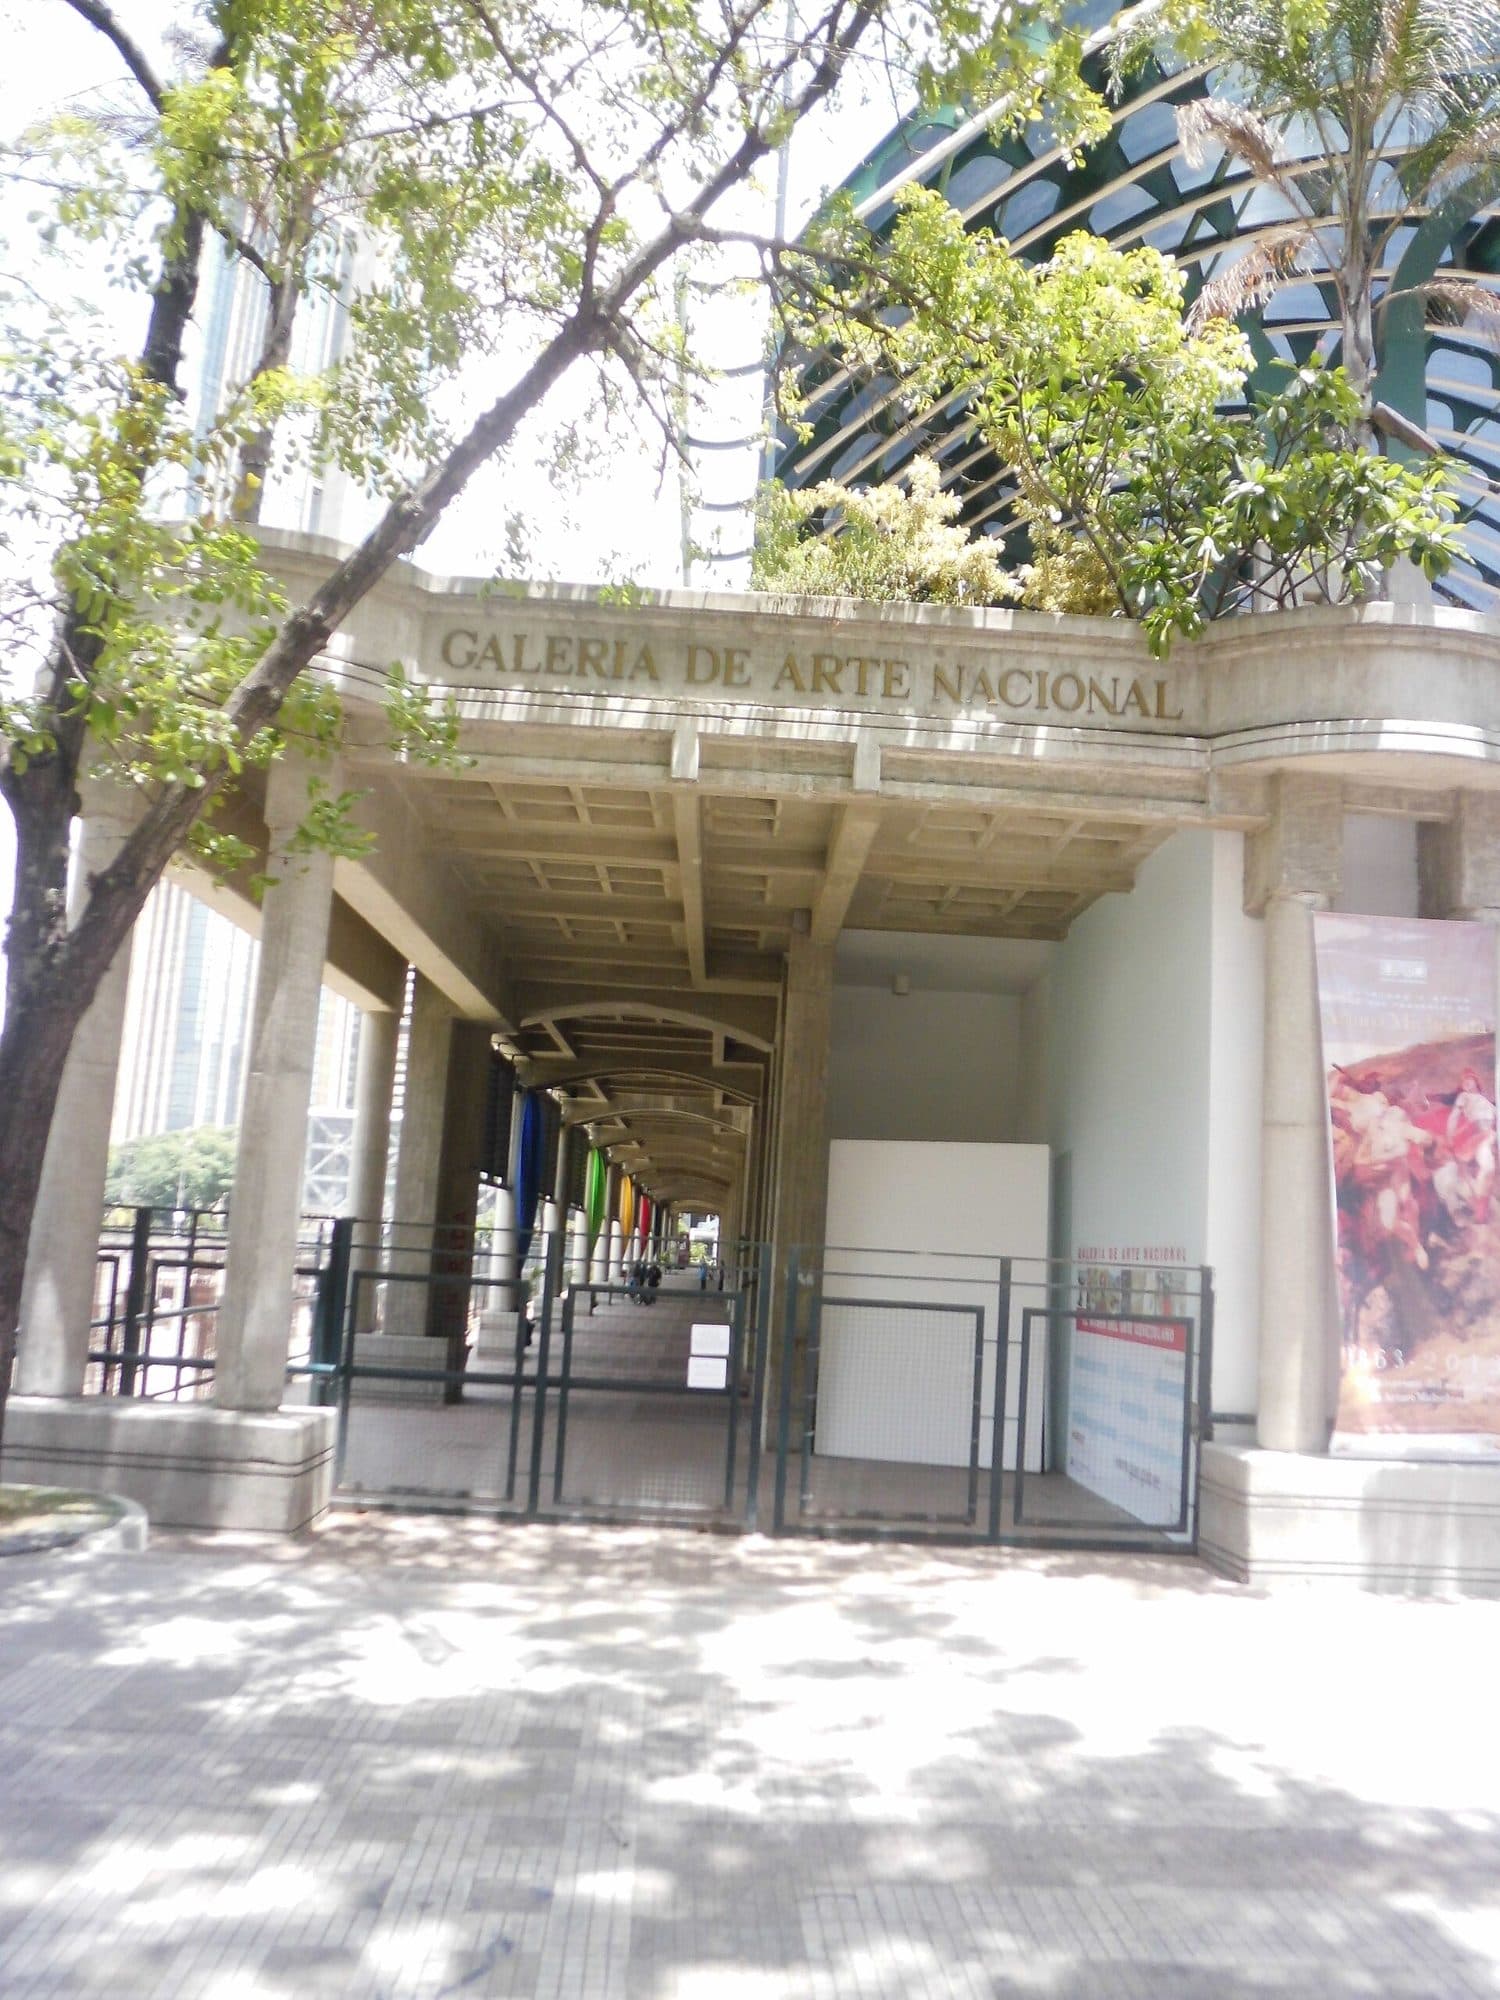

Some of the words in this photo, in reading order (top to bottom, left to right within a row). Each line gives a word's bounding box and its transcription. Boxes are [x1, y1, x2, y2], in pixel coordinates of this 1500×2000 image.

[441, 629, 659, 681] GALERIA
[684, 645, 752, 687] DE
[772, 651, 911, 699] ARTE
[931, 663, 1184, 721] NACIONAL
